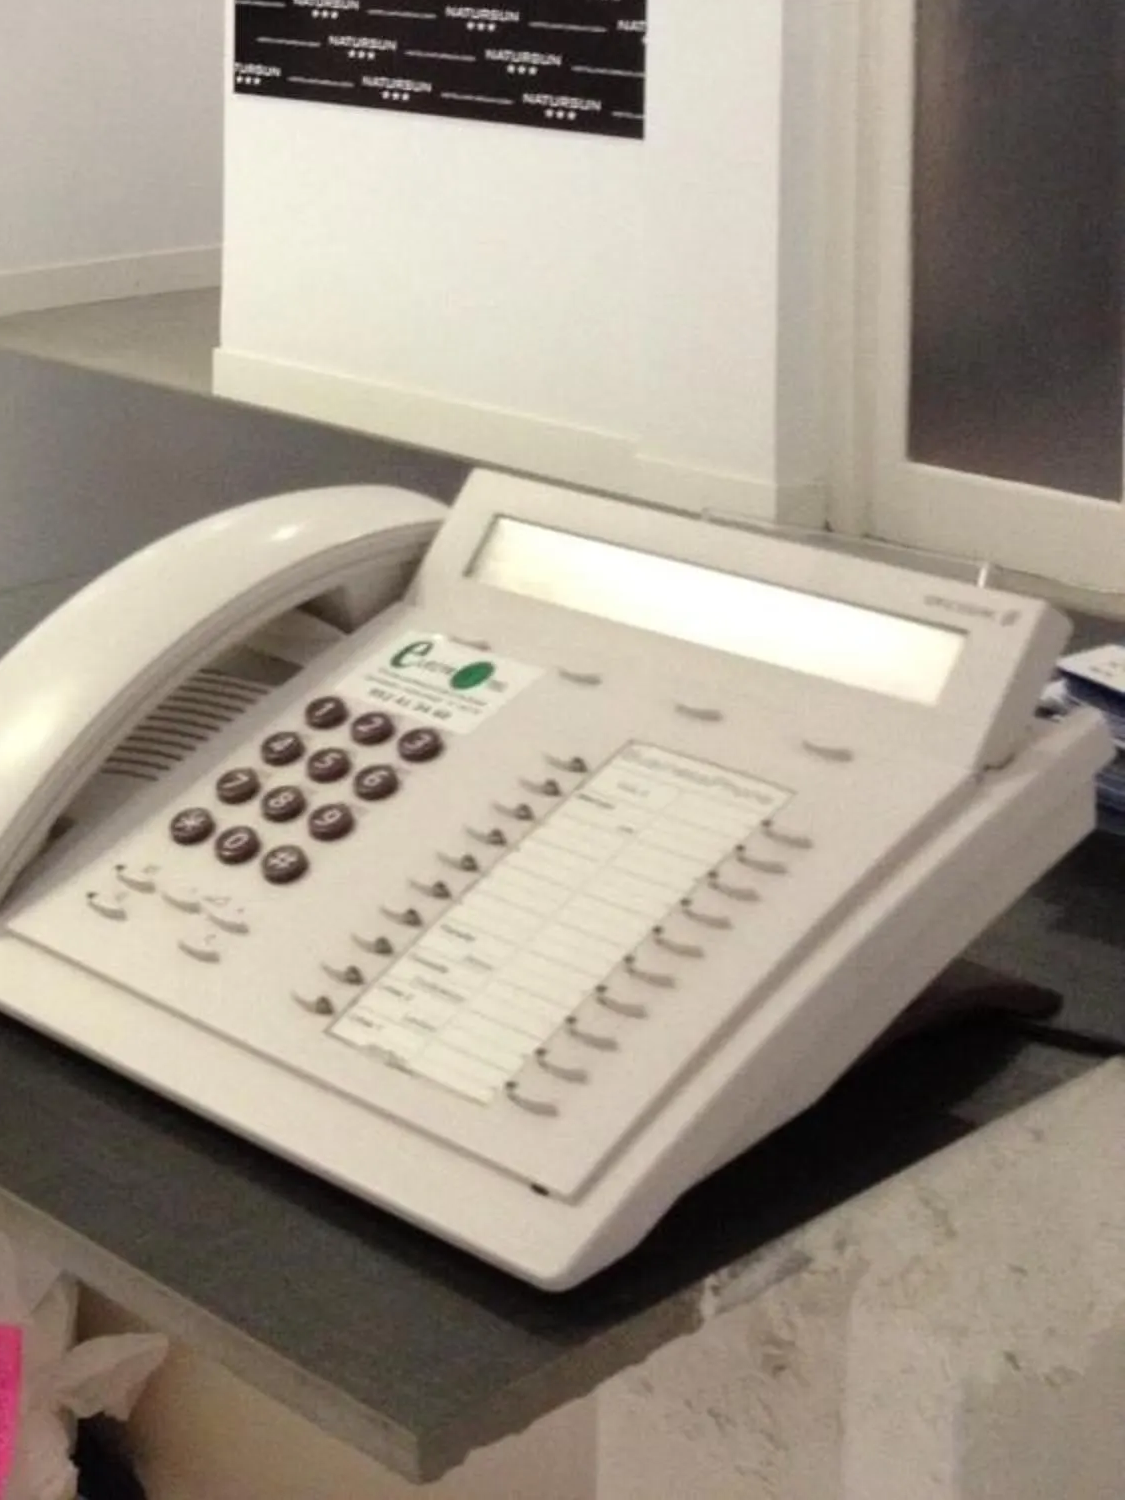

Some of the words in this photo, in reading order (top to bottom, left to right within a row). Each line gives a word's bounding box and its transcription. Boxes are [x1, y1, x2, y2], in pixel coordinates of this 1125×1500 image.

[445, 6, 520, 22] NATURSUN
[328, 35, 398, 51] NATURSUN
[485, 49, 562, 66] NATURSUN
[362, 75, 433, 93] NATURSUN
[522, 93, 602, 111] NATURSUN
[314, 702, 336, 717] 1
[356, 716, 384, 732] 2
[270, 737, 295, 751] 4
[403, 733, 431, 750] 3
[314, 752, 342, 768] 5
[222, 773, 250, 789] 7
[363, 769, 389, 786] 6
[268, 791, 295, 808] 8
[314, 809, 342, 825] 9
[224, 833, 250, 849] 0
